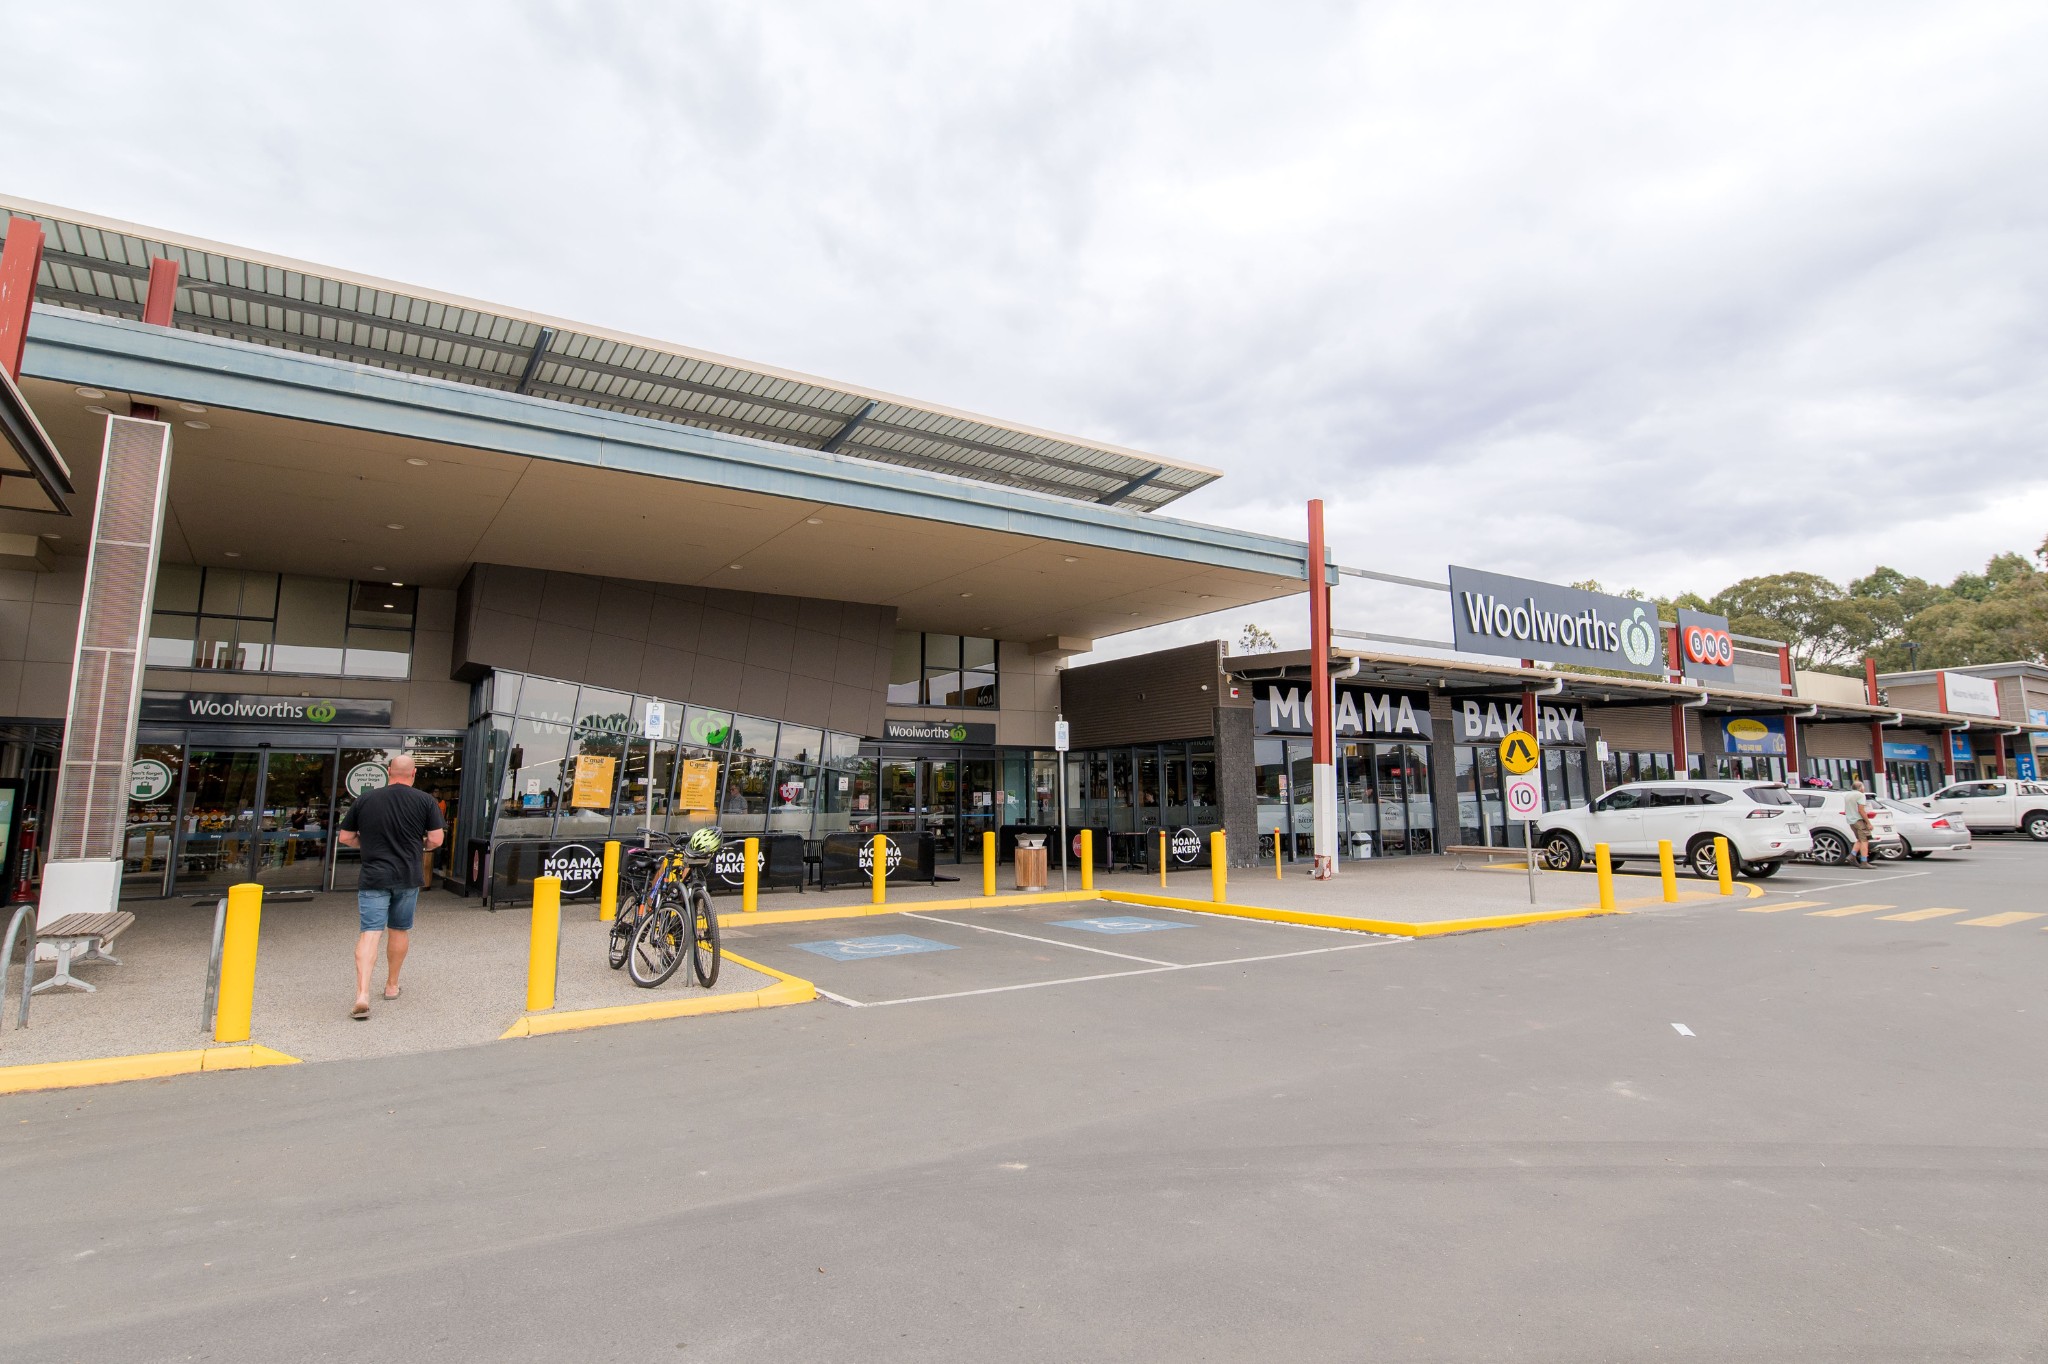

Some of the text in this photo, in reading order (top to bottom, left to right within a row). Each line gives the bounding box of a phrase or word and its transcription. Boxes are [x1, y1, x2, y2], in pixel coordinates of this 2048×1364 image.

[1462, 591, 1620, 652] Woolworths
[977, 694, 994, 706] MOA
[189, 699, 303, 719] Woolworths
[888, 725, 949, 739] Woolworths
[1514, 789, 1532, 805] 10
[1171, 837, 1201, 847] MOAMA
[859, 847, 902, 858] MOMA
[1172, 845, 1202, 855] BAKERY
[544, 857, 603, 870] MOAMA
[715, 852, 765, 863] MOAA
[859, 856, 902, 868] BARY
[715, 861, 765, 874] BAKEY
